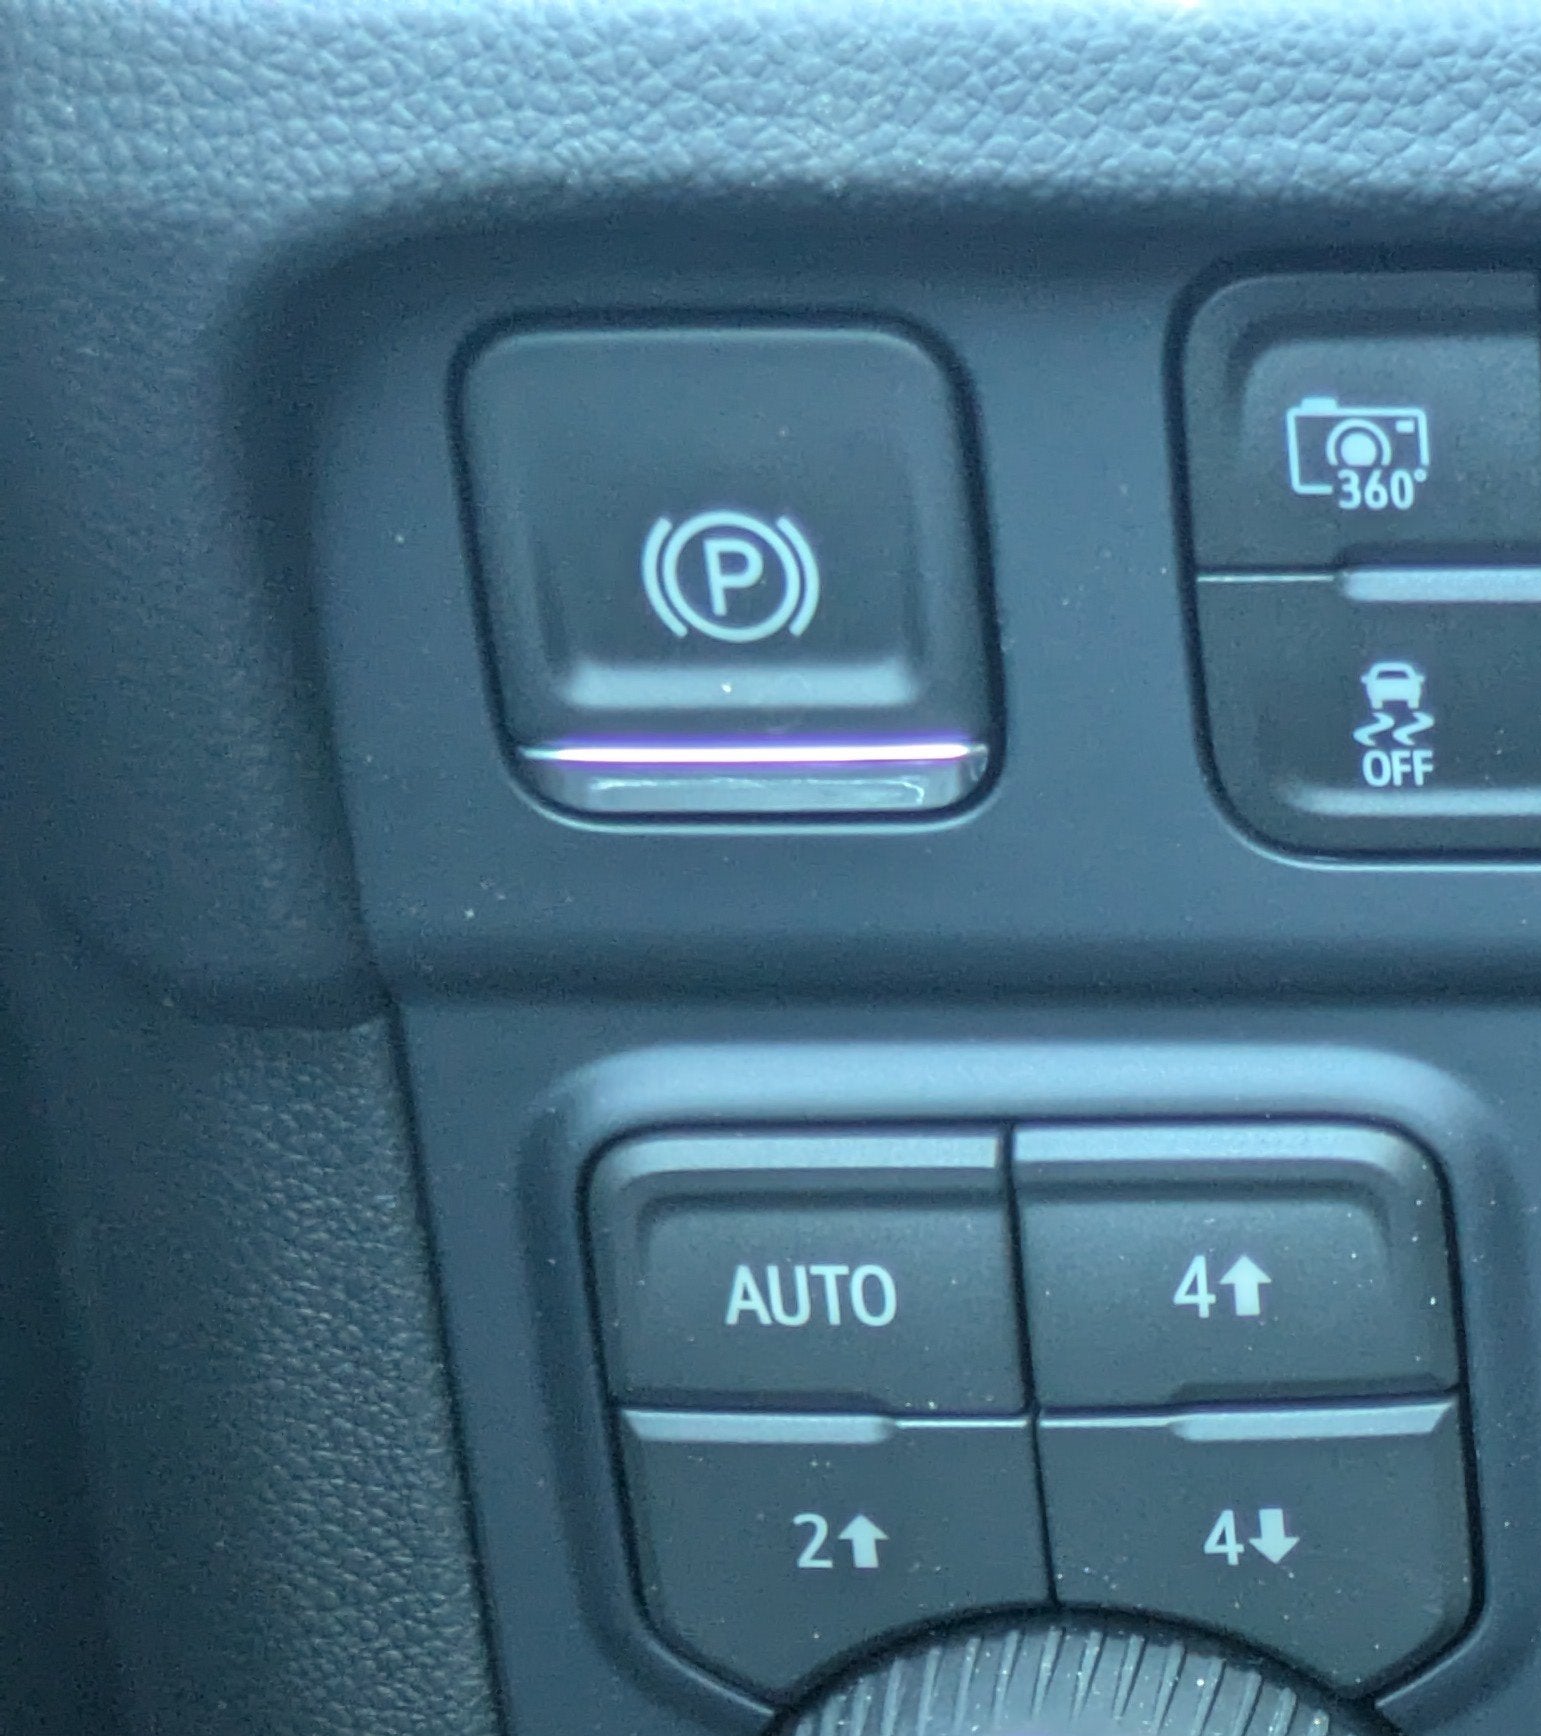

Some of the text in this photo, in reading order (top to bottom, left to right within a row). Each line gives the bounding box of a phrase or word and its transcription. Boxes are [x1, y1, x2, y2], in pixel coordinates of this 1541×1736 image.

[703, 537, 764, 616] P
[1362, 749, 1434, 788] OFF
[727, 1264, 896, 1326] AUTO
[1174, 1255, 1216, 1318] 4
[793, 1513, 833, 1568] 2
[1204, 1510, 1244, 1565] 4
